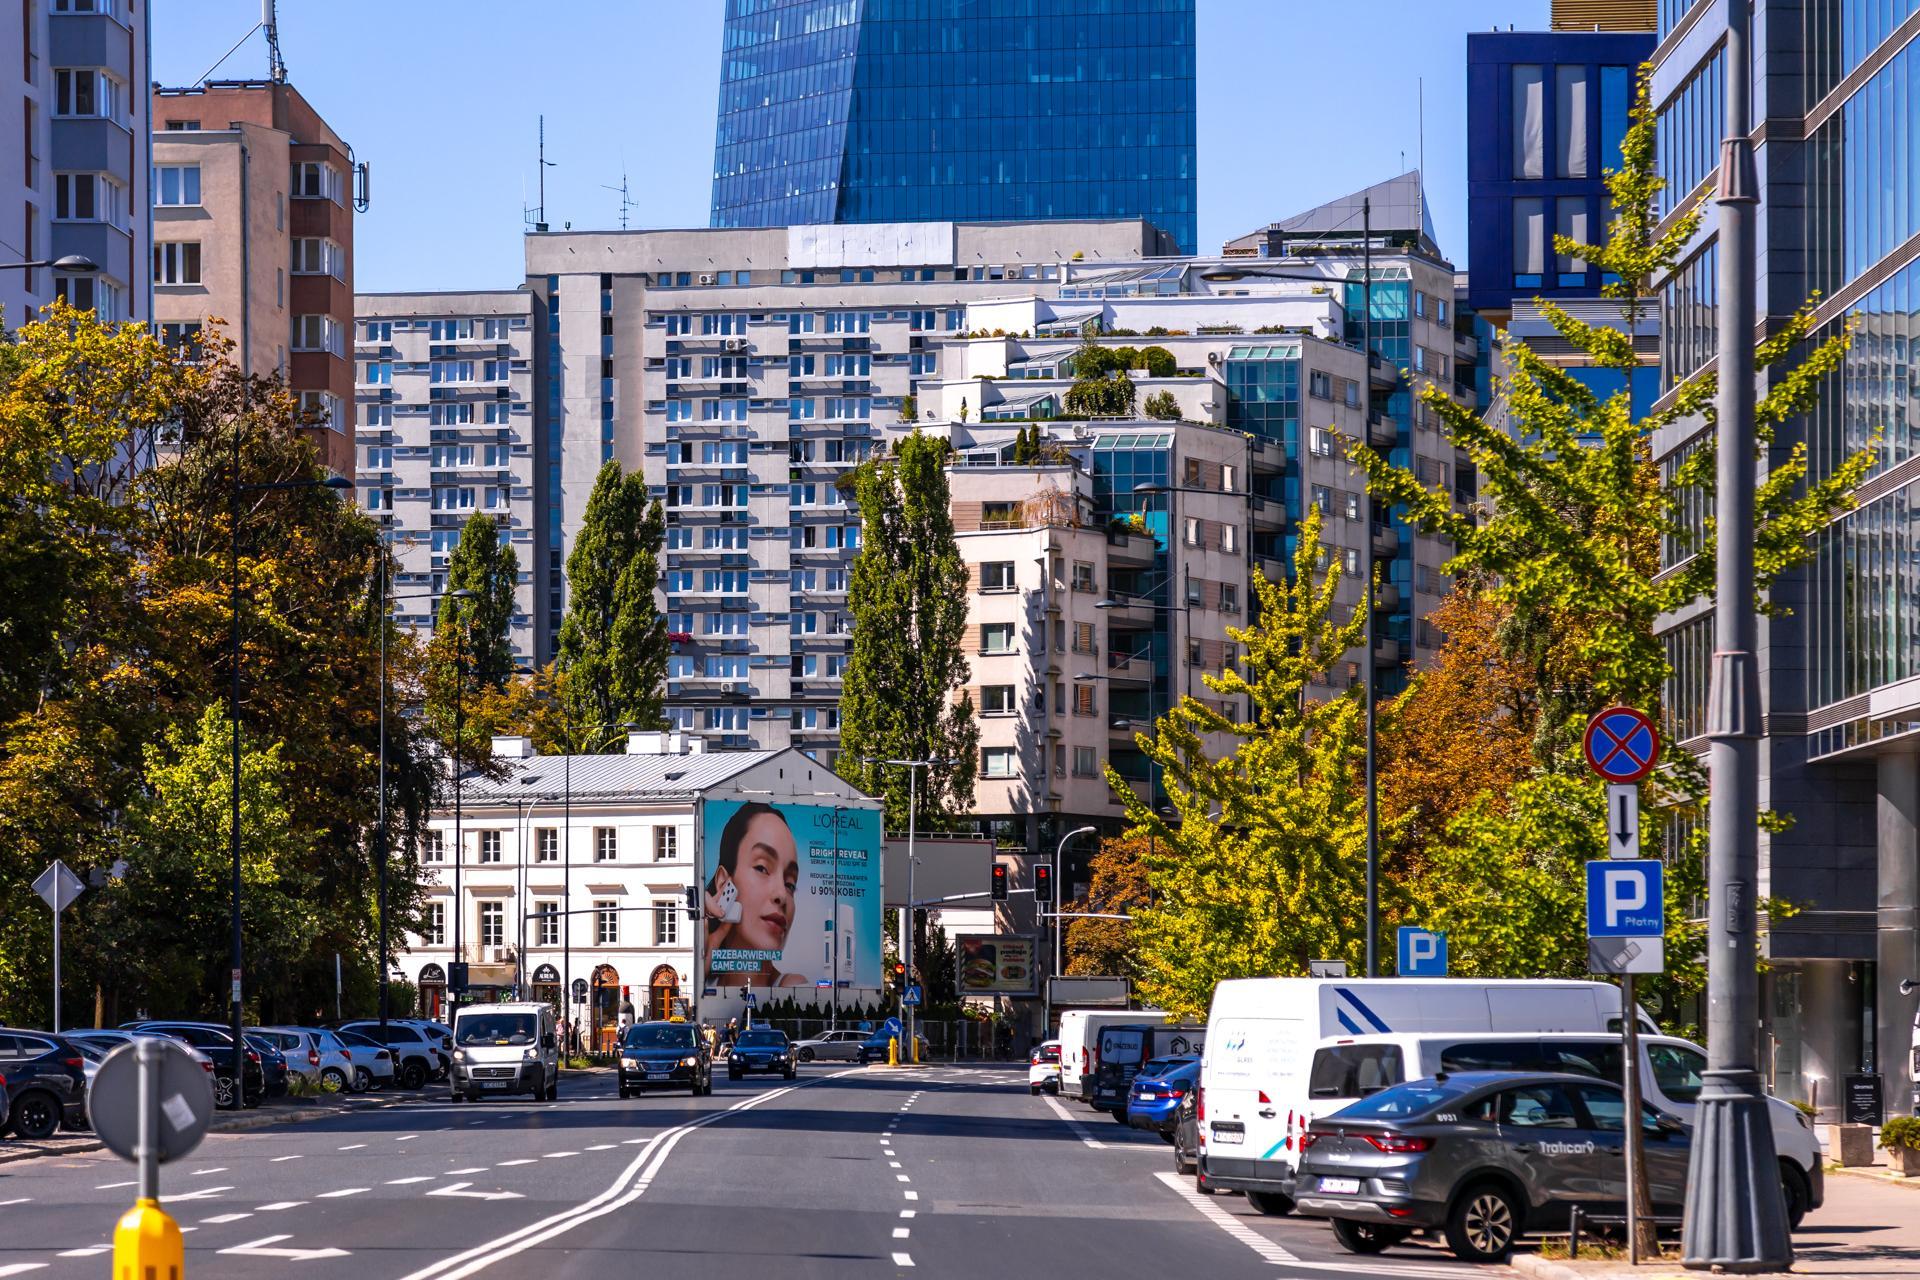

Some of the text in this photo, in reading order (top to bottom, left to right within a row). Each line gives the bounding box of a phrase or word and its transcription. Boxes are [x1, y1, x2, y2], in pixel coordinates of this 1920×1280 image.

[839, 850, 867, 860] REVEAL
[811, 886, 866, 898] U 90% KOBIET
[1605, 869, 1647, 927] P
[1625, 916, 1659, 929] Płatny
[711, 949, 781, 960] PRZEBARWIENIA?
[1409, 932, 1437, 971] P
[711, 960, 760, 972] GAME OVER.
